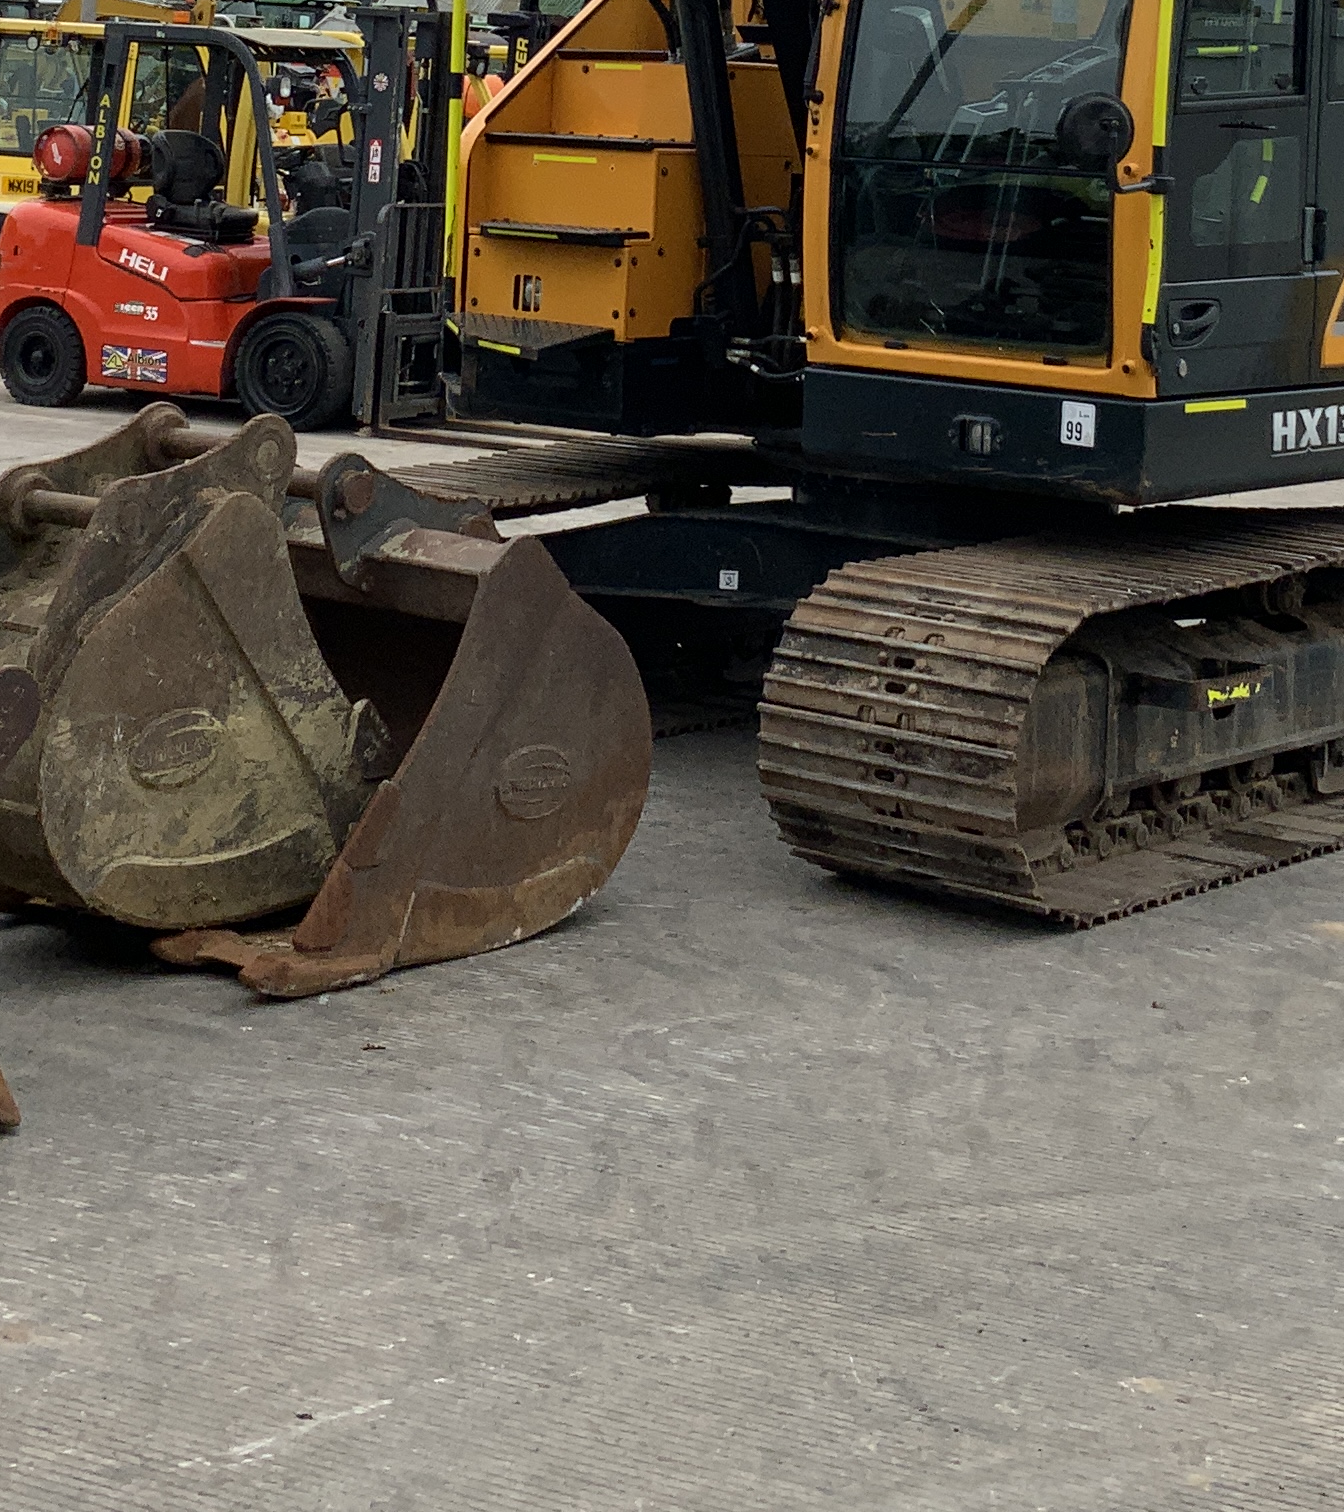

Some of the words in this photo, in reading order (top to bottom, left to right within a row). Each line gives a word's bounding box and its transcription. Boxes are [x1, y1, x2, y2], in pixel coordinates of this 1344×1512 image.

[87, 93, 111, 186] ALBION
[118, 247, 169, 282] HELI
[143, 305, 159, 321] 35
[127, 352, 162, 366] Albion
[1066, 420, 1083, 441] 99
